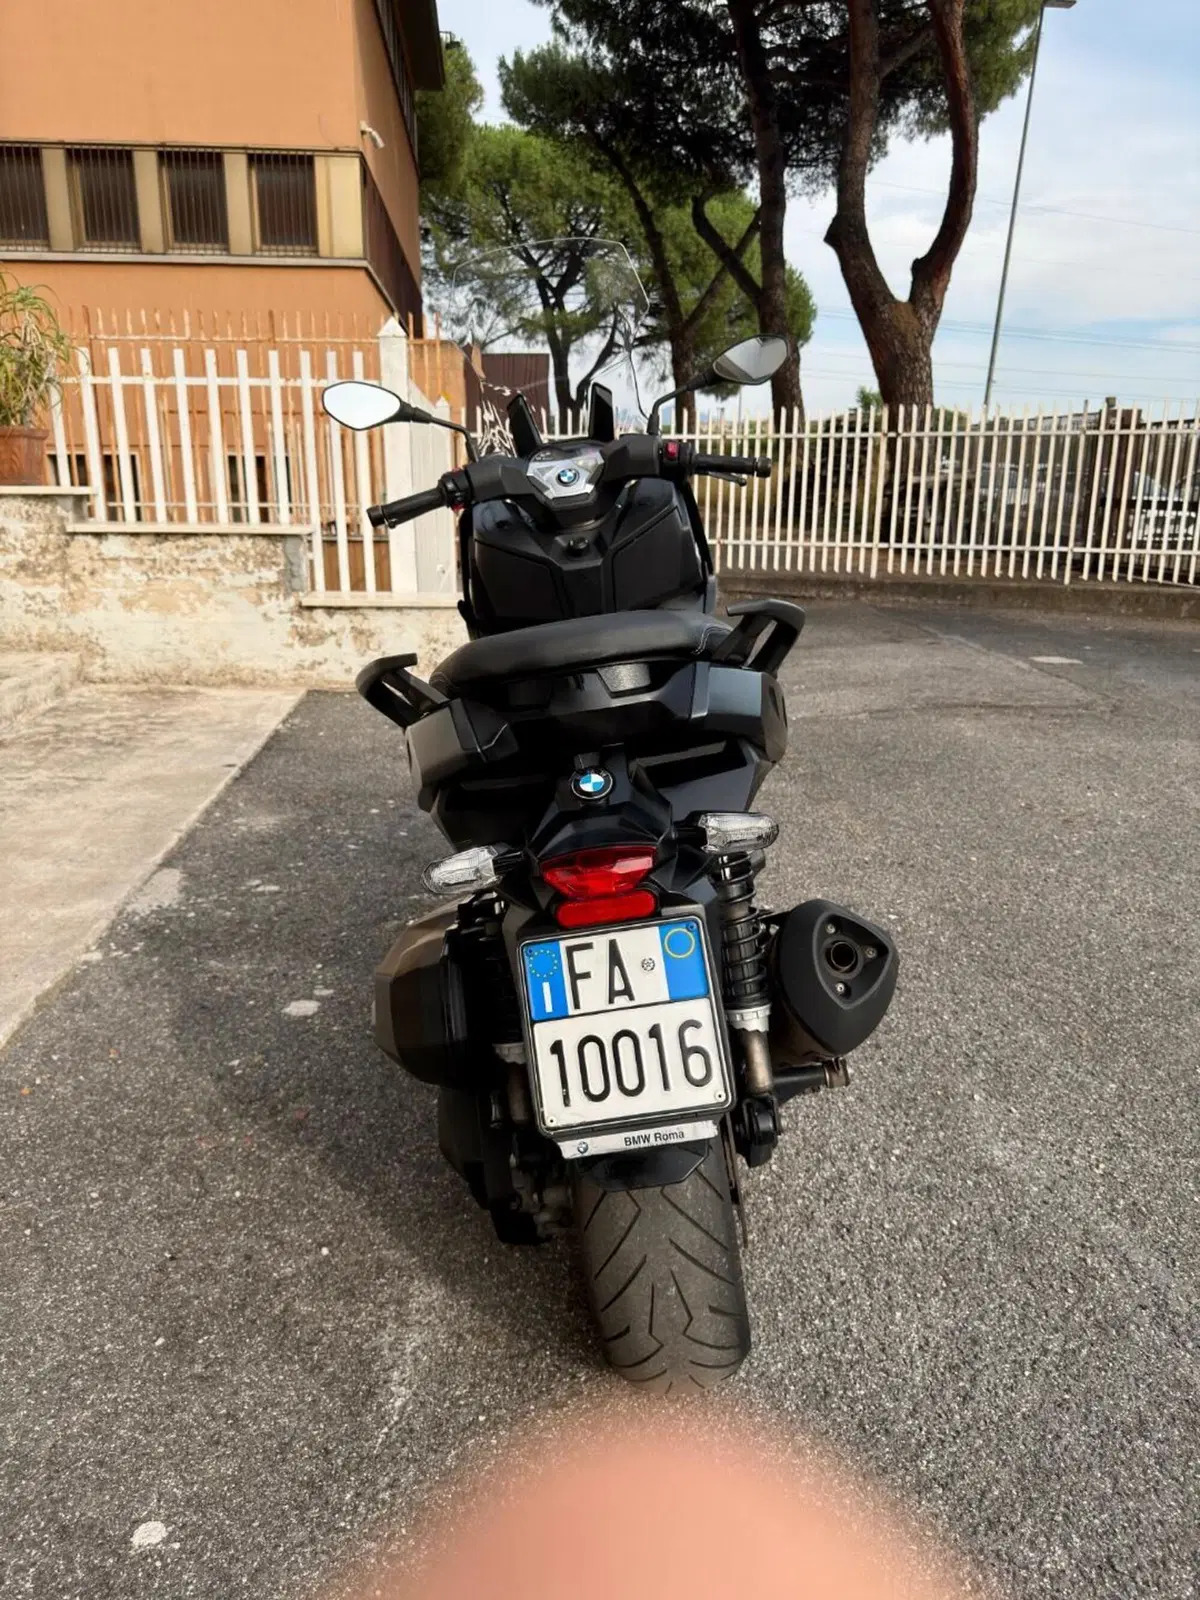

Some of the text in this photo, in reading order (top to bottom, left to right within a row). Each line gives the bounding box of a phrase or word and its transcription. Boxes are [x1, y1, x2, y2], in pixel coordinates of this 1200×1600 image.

[542, 981, 553, 1013] I
[565, 938, 636, 1010] FA
[549, 1019, 713, 1108] 10016
[623, 1130, 685, 1147] BMW Roma
